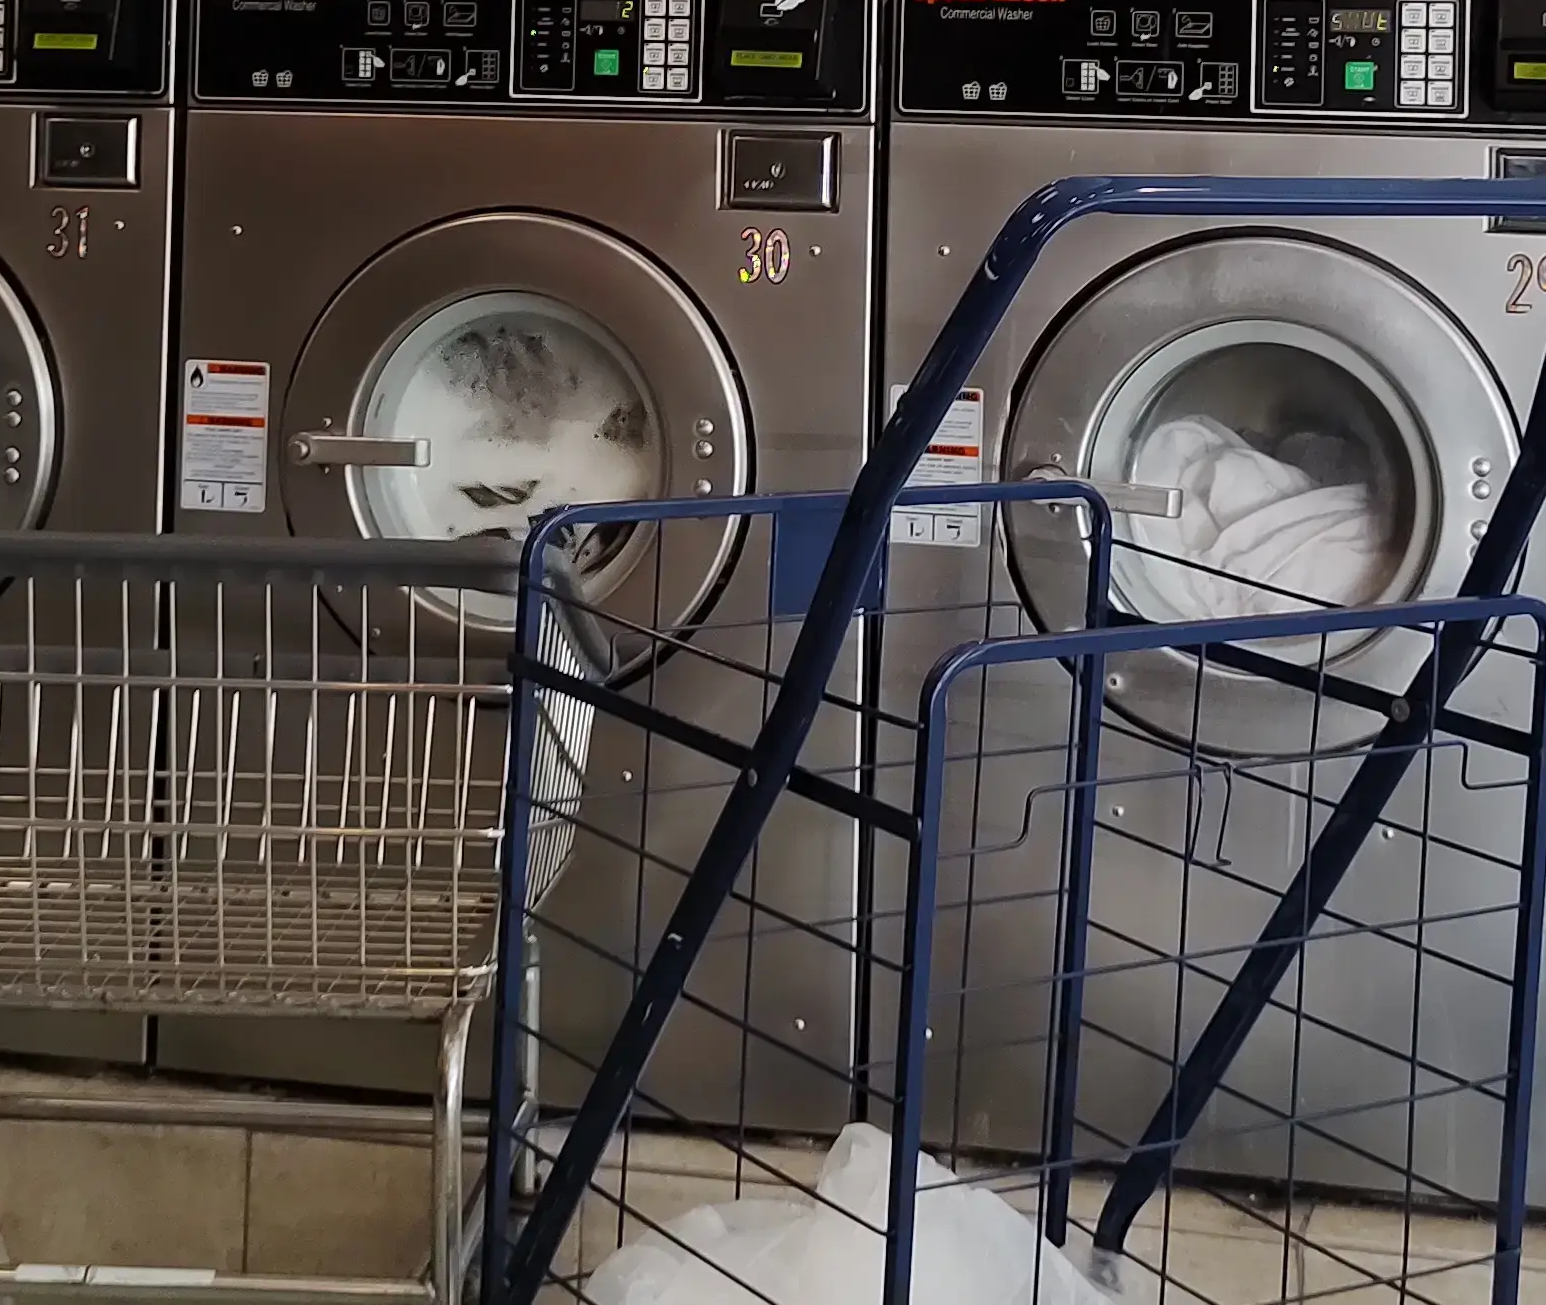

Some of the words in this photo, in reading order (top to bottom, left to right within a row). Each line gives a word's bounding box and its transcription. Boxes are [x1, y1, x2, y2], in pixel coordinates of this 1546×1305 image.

[939, 6, 996, 21] Commercial
[998, 6, 1035, 21] Washer
[45, 205, 92, 259] 31
[737, 226, 791, 285] 30
